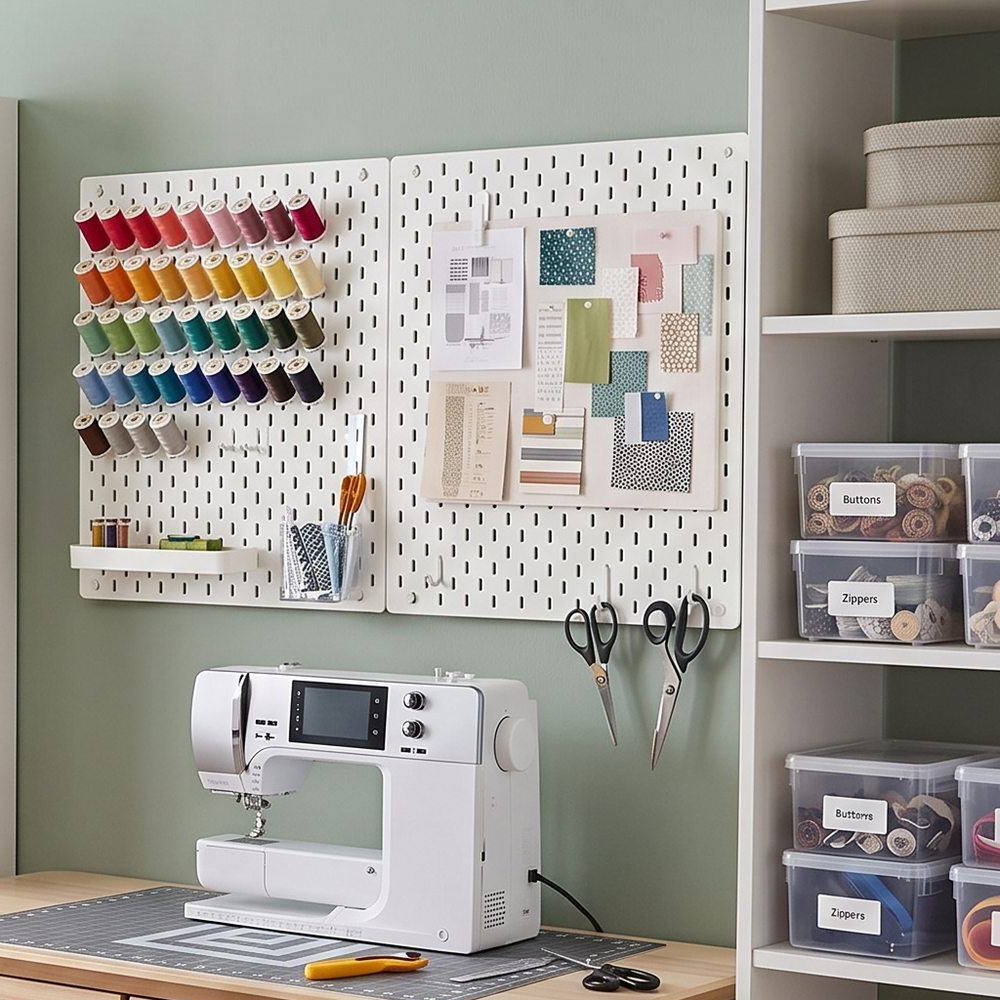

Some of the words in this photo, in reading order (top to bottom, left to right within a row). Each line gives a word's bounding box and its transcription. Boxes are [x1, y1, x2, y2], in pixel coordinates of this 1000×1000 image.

[843, 494, 881, 505] Buttons
[842, 593, 878, 606] Zippers
[831, 907, 865, 921] Zippers
